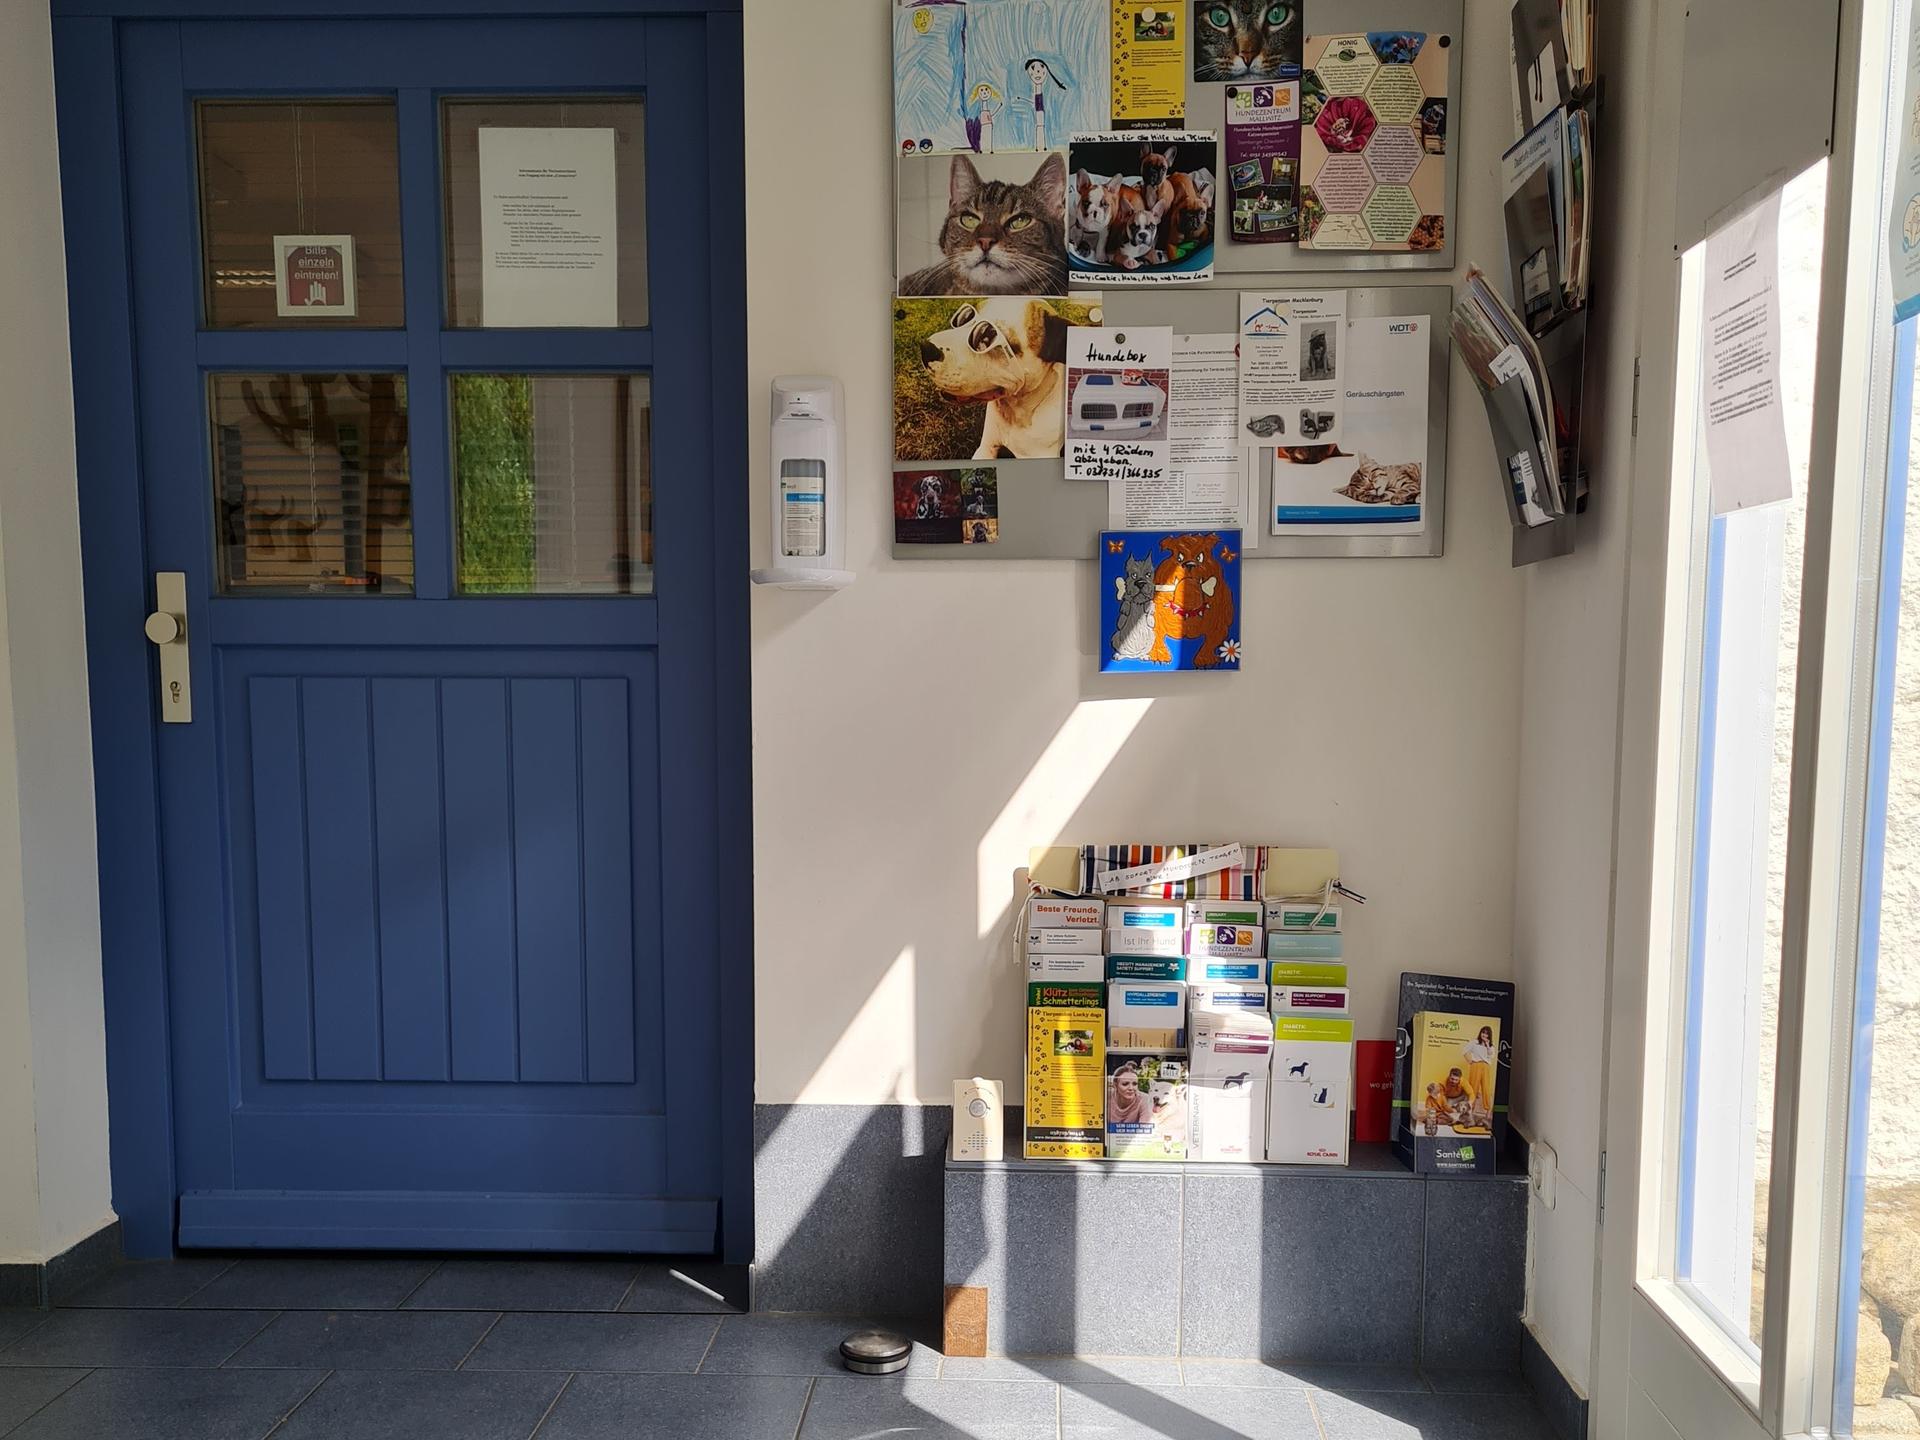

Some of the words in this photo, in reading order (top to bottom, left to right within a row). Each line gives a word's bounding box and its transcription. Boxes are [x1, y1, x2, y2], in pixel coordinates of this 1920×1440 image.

[1235, 107, 1291, 117] HUNDEZENTRUM
[1150, 133, 1170, 142] Hilfe
[1186, 133, 1213, 143] Pflege
[298, 256, 335, 267] einzeln
[294, 271, 339, 280] eintreten!
[1389, 324, 1410, 332] WDT
[1086, 342, 1147, 363] Hundebox
[1345, 390, 1405, 398] Geräuschängsten
[1073, 443, 1096, 455] mit
[1103, 444, 1110, 455] 4
[1070, 465, 1082, 475] T.
[1063, 905, 1100, 914] Freunde.
[1124, 937, 1136, 945] Ist
[1137, 937, 1150, 945] Ihr
[1152, 936, 1176, 946] Hund
[1043, 987, 1068, 997] Klütz
[1414, 981, 1437, 989] Spezialist
[1445, 984, 1509, 997] Tierkrankenversicherungen
[1042, 997, 1099, 1007] Schmetterlings
[1192, 1093, 1200, 1149] VETERINARY
[1436, 1148, 1475, 1159] SantéVet
